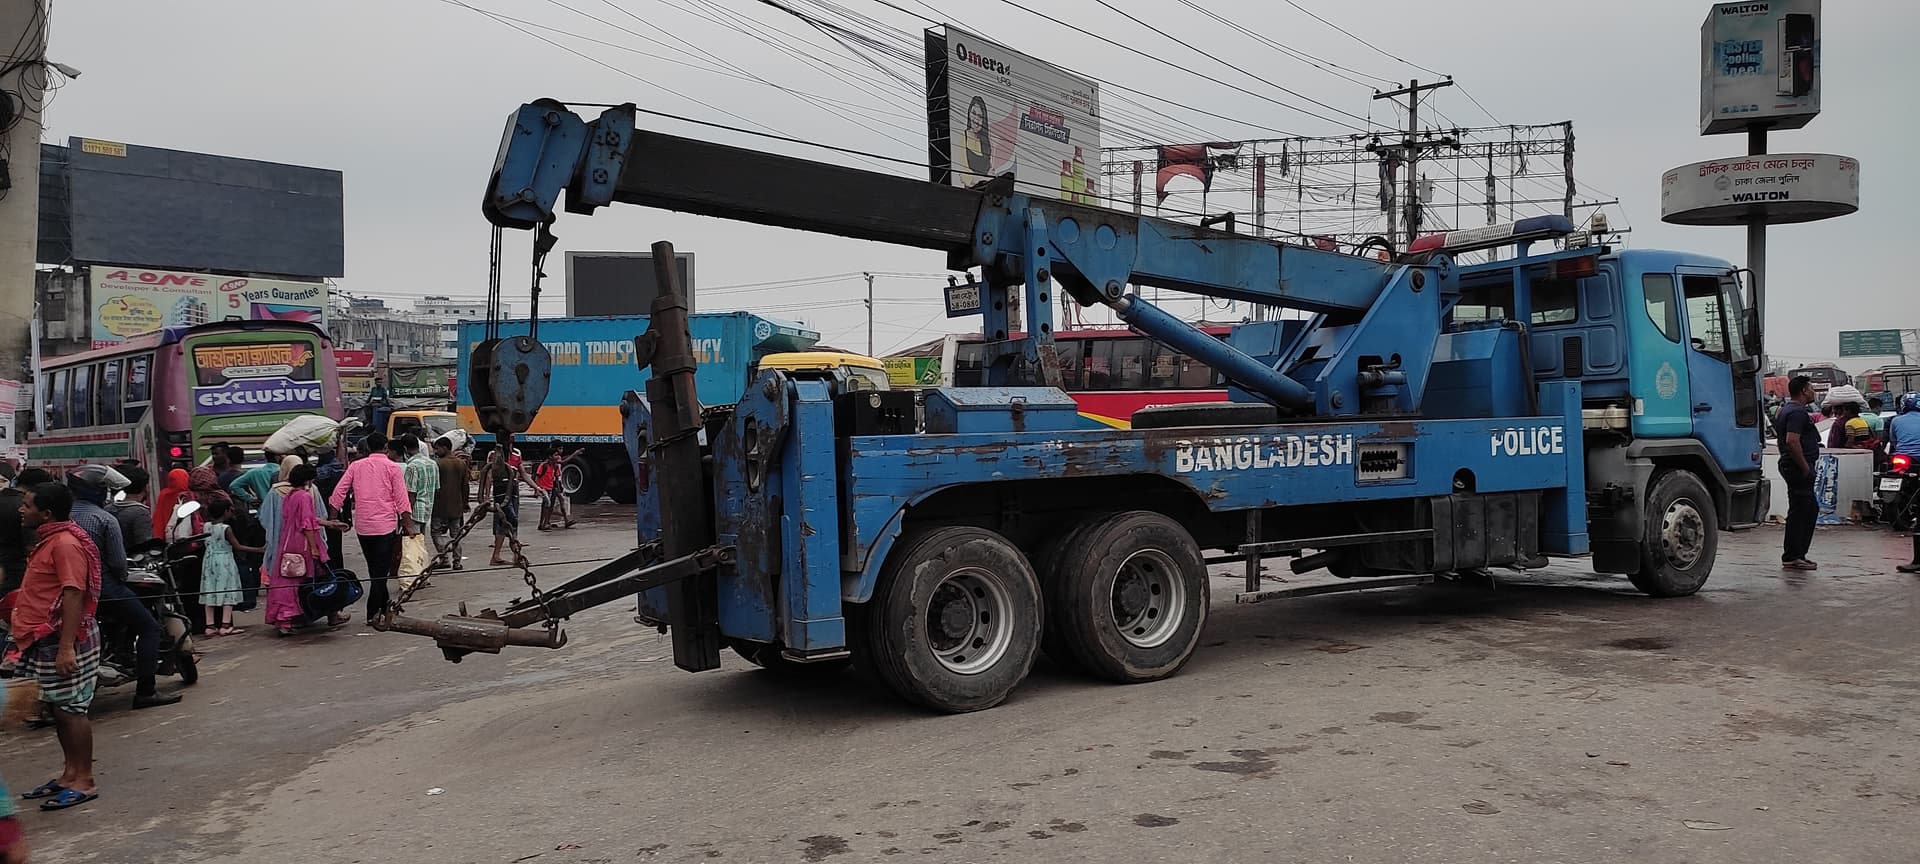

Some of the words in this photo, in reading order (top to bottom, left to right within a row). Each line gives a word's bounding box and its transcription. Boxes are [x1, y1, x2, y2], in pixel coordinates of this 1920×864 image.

[1721, 4, 1768, 15] WALTON
[956, 43, 1004, 75] Omera
[1699, 162, 1729, 177] ট্রাফিক
[1732, 160, 1760, 171] আইন
[1764, 159, 1788, 169] মেনে
[1791, 159, 1815, 170] চলুন
[1735, 178, 1753, 186] ঢাকা
[1755, 176, 1776, 185] জেলা
[1732, 191, 1789, 202] WALTON
[228, 294, 241, 308] 5
[241, 290, 269, 301] Years
[272, 287, 319, 301] Guarantee
[198, 388, 321, 407] EXCLUSIVE
[1490, 426, 1563, 457] POLICE
[1176, 434, 1352, 473] BANGLADESH
